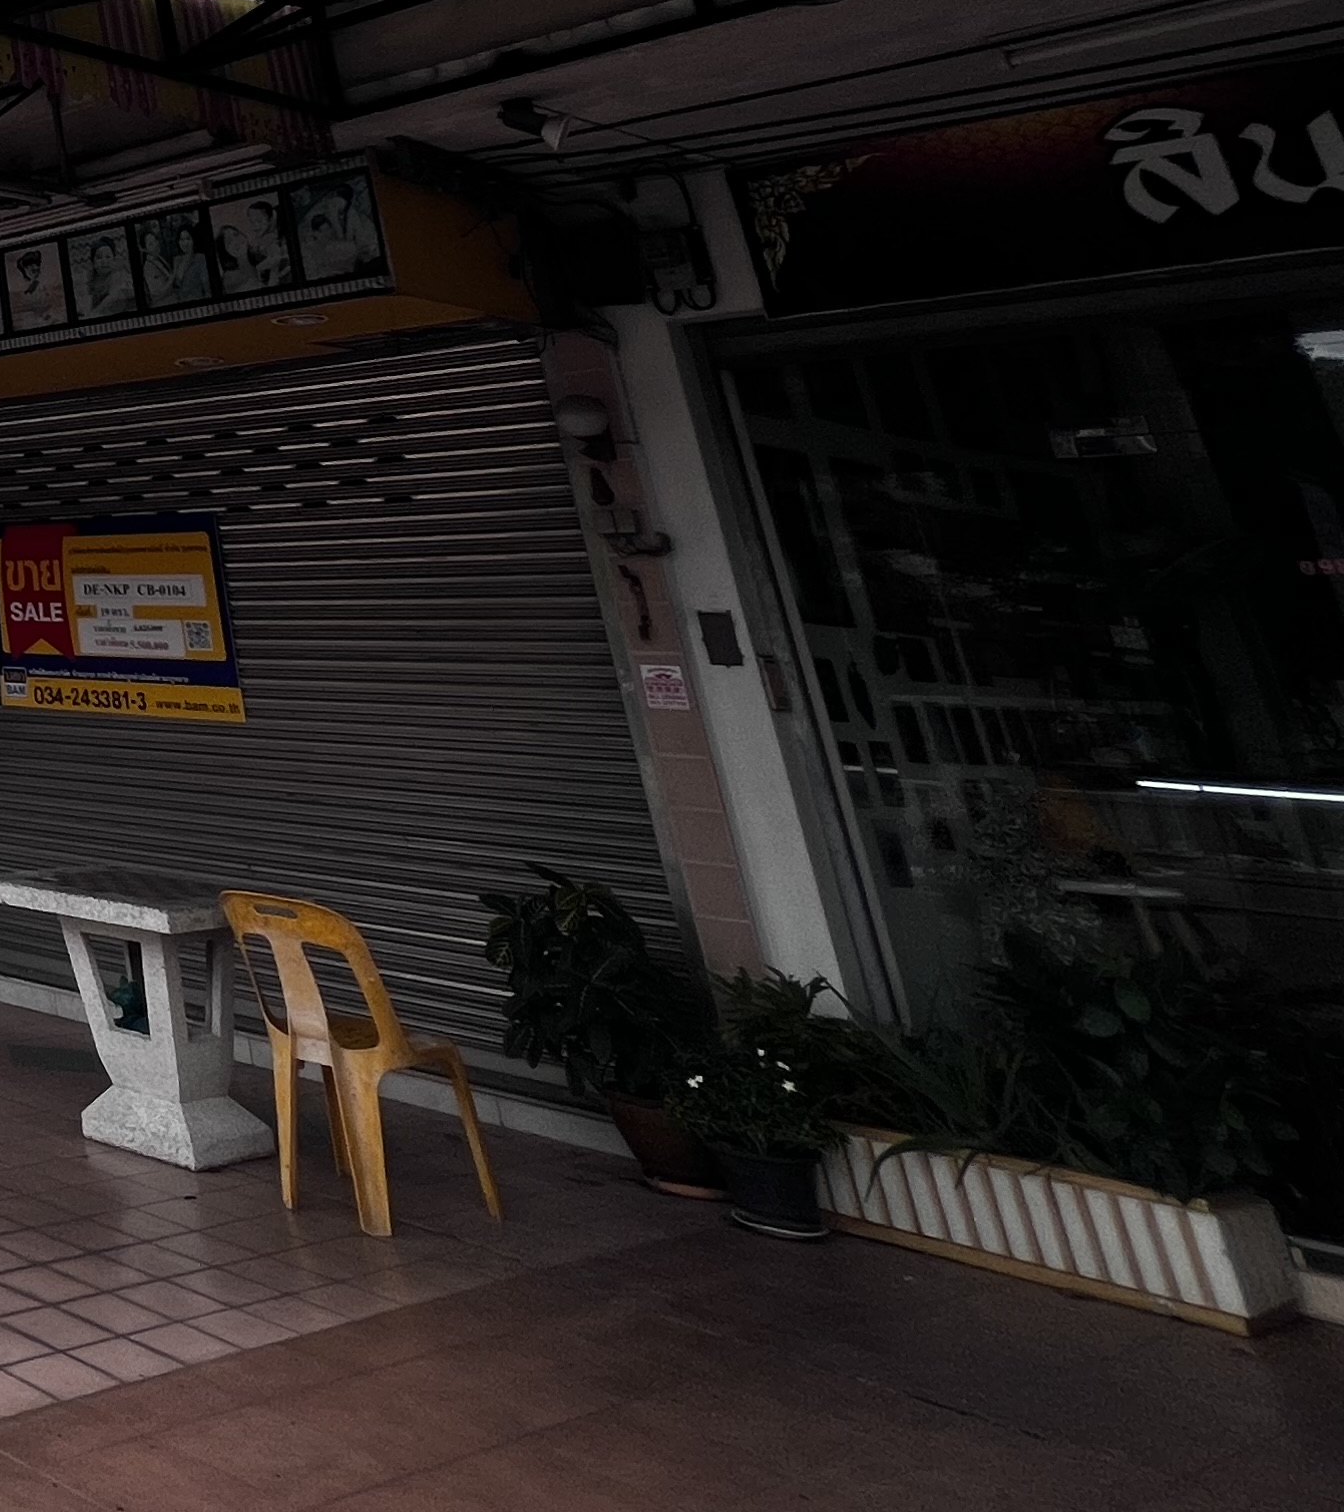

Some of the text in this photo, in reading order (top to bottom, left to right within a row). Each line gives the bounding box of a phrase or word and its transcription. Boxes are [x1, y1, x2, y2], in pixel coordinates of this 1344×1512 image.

[4, 558, 63, 593] ขาย
[9, 601, 64, 623] SALE
[33, 686, 241, 715] 034-243381-3 www.bam.co.th
